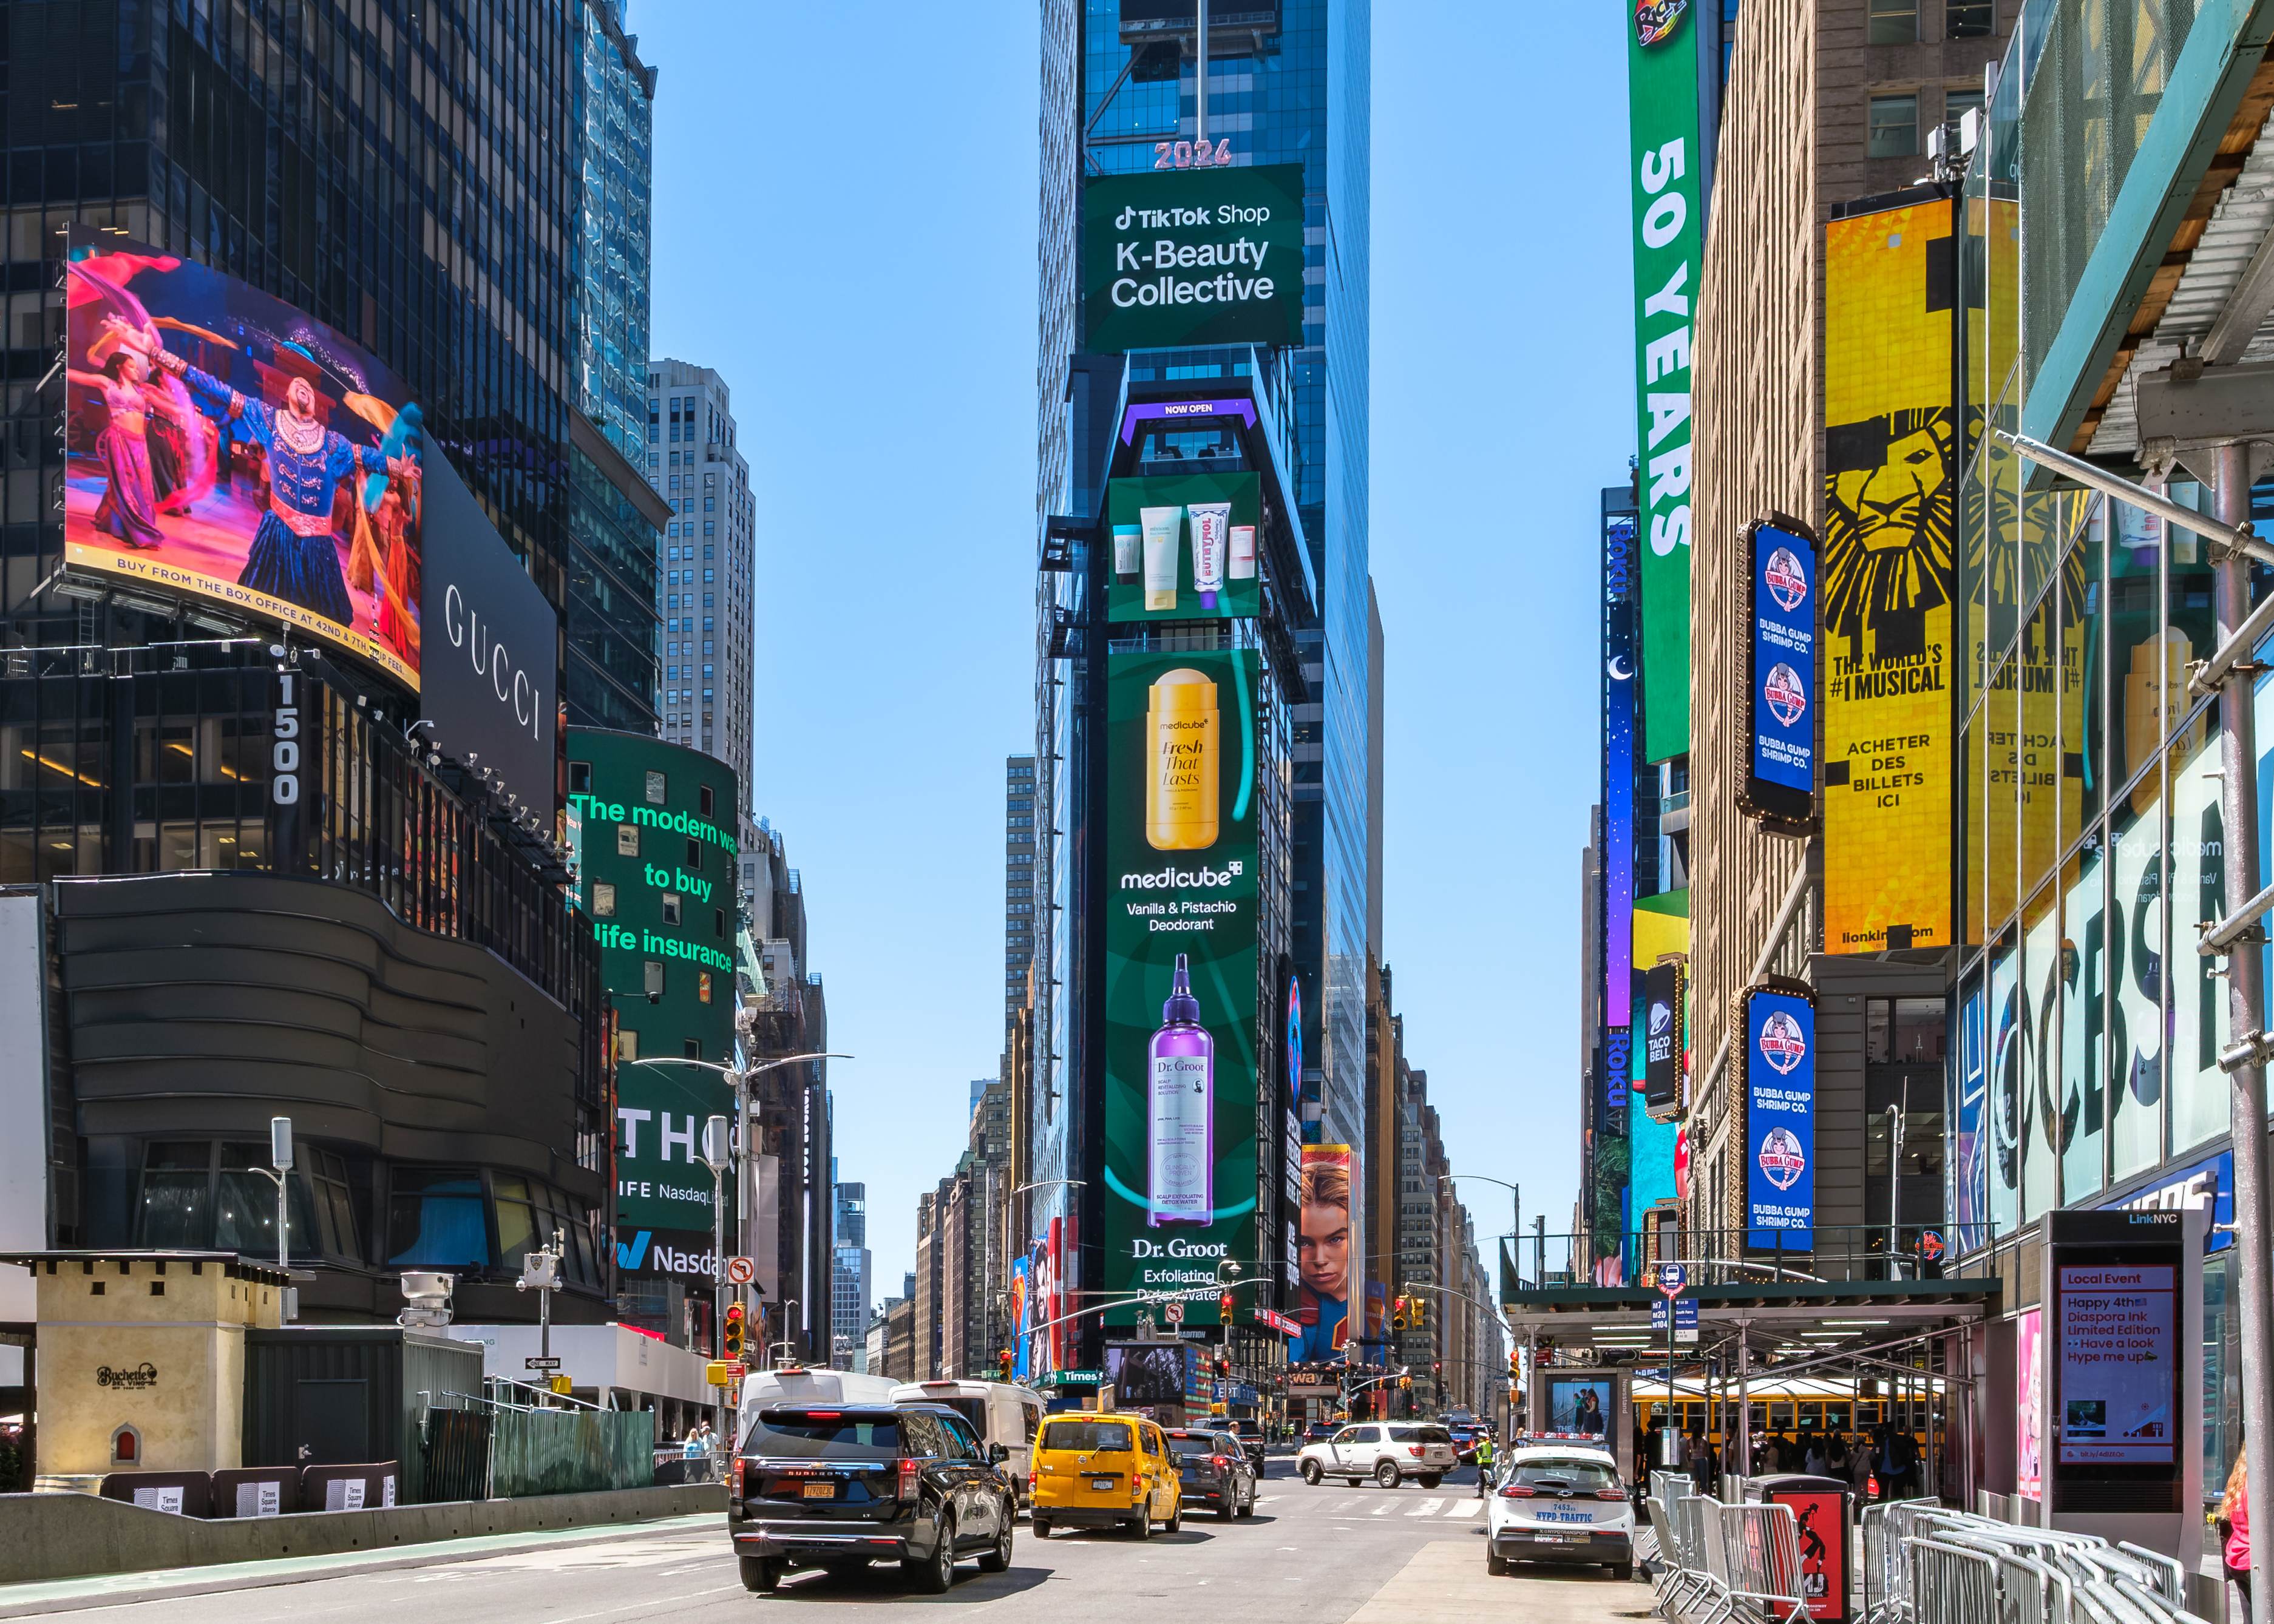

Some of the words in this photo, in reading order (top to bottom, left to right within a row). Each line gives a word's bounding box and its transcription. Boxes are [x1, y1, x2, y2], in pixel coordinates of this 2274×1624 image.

[1155, 138, 1232, 169] 2026
[1641, 136, 1686, 249] 50
[1139, 207, 1210, 228] TikTok
[1217, 205, 1270, 226] Shop
[1117, 237, 1269, 271] K-Beauty
[1111, 272, 1274, 308] Collective
[1165, 405, 1187, 414] NOW
[1189, 404, 1213, 413] OPEN
[1644, 259, 1691, 558] YEARS
[1203, 518, 1214, 577] EUTHYMOL
[1766, 572, 1787, 588] BUBBA
[1788, 578, 1807, 595] GUMP
[117, 558, 146, 573] BUY
[152, 567, 191, 584] FROM
[197, 578, 222, 593] THE
[226, 587, 251, 603] BOX
[256, 594, 297, 619] OFFICE
[300, 614, 313, 625] AT
[316, 621, 341, 637] 42ND
[344, 634, 348, 642] &
[1759, 618, 1787, 636] BUBBA
[1788, 626, 1811, 643] GUMP
[1762, 631, 1792, 649] SHRIMP
[1794, 640, 1808, 654] CO.
[445, 584, 540, 740] GUCCI
[1833, 654, 1864, 677] THE
[1868, 643, 1943, 669] WORLD'S
[1854, 665, 1945, 700] MUSICAL
[1765, 688, 1787, 705] BUBBA
[1788, 693, 1806, 710] GUMP
[1160, 721, 1204, 730] medicube
[273, 675, 299, 805] 1500
[1162, 739, 1203, 754] Fresh
[1759, 735, 1786, 753] BUBBA
[1787, 742, 1811, 759] GUMP
[1847, 734, 1930, 756] ACHETER
[1165, 755, 1199, 771] That
[1762, 747, 1791, 766] SHRIMP
[1793, 756, 1807, 770] CO.
[1872, 756, 1906, 771] DES
[1162, 771, 1200, 786] Lasts
[1853, 773, 1924, 793] BILLETS
[1877, 794, 1900, 808] ICI
[569, 794, 625, 822] The
[633, 807, 717, 844] modern
[720, 829, 738, 862] way
[645, 863, 669, 887] to
[676, 868, 712, 903] buy
[1121, 867, 1232, 889] medicube
[1127, 902, 1165, 915] Vanilla
[1169, 902, 1178, 915] &
[1181, 901, 1237, 913] Pistachio
[1149, 918, 1213, 932] Deodorant
[1842, 926, 1933, 944] lionkinom
[594, 924, 636, 950] life
[643, 929, 732, 973] insurance
[1648, 1035, 1671, 1051] TACO
[1761, 1039, 1784, 1049] BUBBA
[1785, 1040, 1804, 1054] GUMP
[1649, 1047, 1671, 1063] BELL
[1158, 1062, 1172, 1072] Dr.
[1175, 1060, 1204, 1072] Groot
[1754, 1087, 1784, 1100] BUBBA
[1785, 1089, 1811, 1102] GUMP
[1757, 1098, 1790, 1111] SHRIMP
[1791, 1101, 1807, 1114] CO.
[1760, 1154, 1784, 1166] BUBBA
[1784, 1155, 1804, 1169] GUMP
[619, 1181, 651, 1197] IFE
[1753, 1204, 1783, 1217] BUBBA
[1784, 1206, 1810, 1219] GUMP
[2129, 1214, 2177, 1225] LinkNYC
[1756, 1216, 1790, 1229] SHRIMP
[1791, 1219, 1807, 1229] CO.
[1133, 1239, 1164, 1258] Dr.
[1168, 1238, 1227, 1257] Groot
[1144, 1270, 1215, 1284] Exfoliating
[2068, 1273, 2102, 1284] Local
[2105, 1273, 2142, 1284] Event
[2068, 1298, 2109, 1310] Happy
[2113, 1297, 2135, 1308] 4th
[1652, 1310, 1666, 1319] M20
[2068, 1312, 2125, 1324] Diaspora
[2128, 1311, 2147, 1322] Ink
[1652, 1320, 1668, 1328] M104
[2068, 1325, 2114, 1335] Limited
[2117, 1325, 2160, 1335] Edition
[2081, 1339, 2113, 1348] Have
[2128, 1338, 2154, 1348] look
[2068, 1353, 2100, 1365] Hype
[2128, 1354, 2144, 1364] up
[1065, 1372, 1097, 1381] Times
[1536, 1512, 1556, 1521] NYPD
[1560, 1513, 1592, 1522] TRAFFIC
